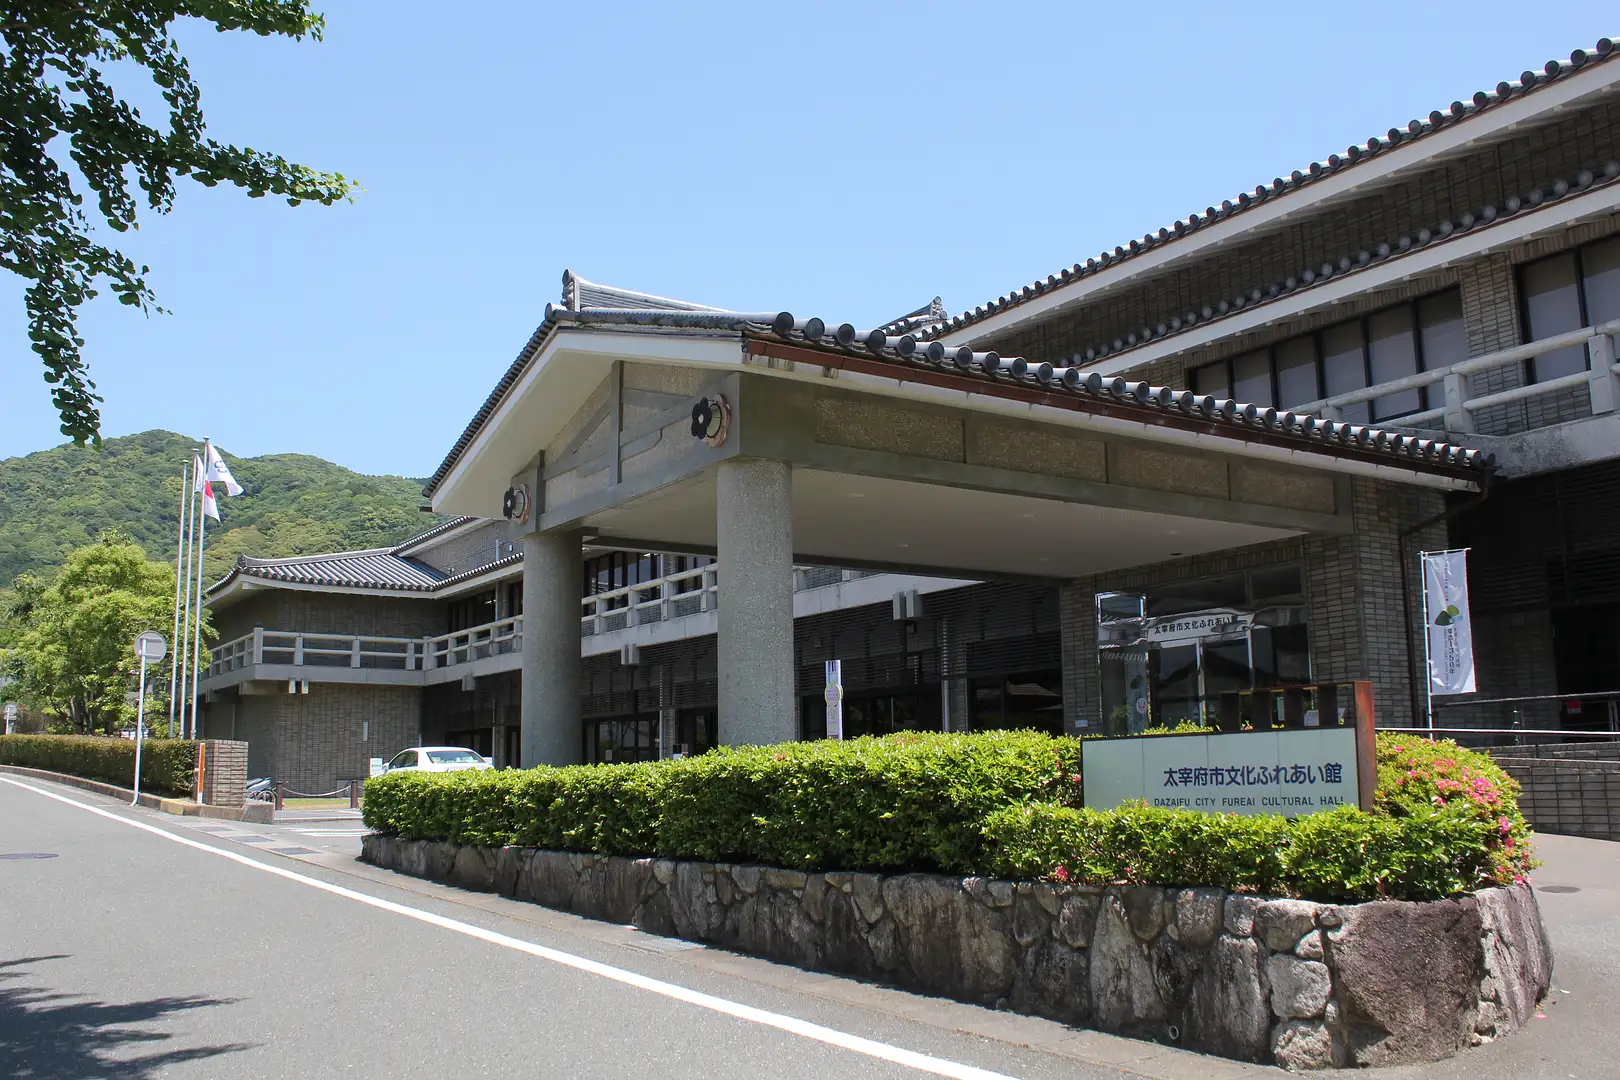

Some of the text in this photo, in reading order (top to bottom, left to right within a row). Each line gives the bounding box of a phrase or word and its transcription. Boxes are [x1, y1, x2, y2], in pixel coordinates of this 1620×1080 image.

[1163, 762, 1342, 787] 太宰府市文化ふれあい館
[1154, 798, 1190, 807] DAZAIFU
[1195, 797, 1216, 807] CITY
[1222, 797, 1255, 806] FUREAI
[1262, 796, 1314, 806] CULTURAL
